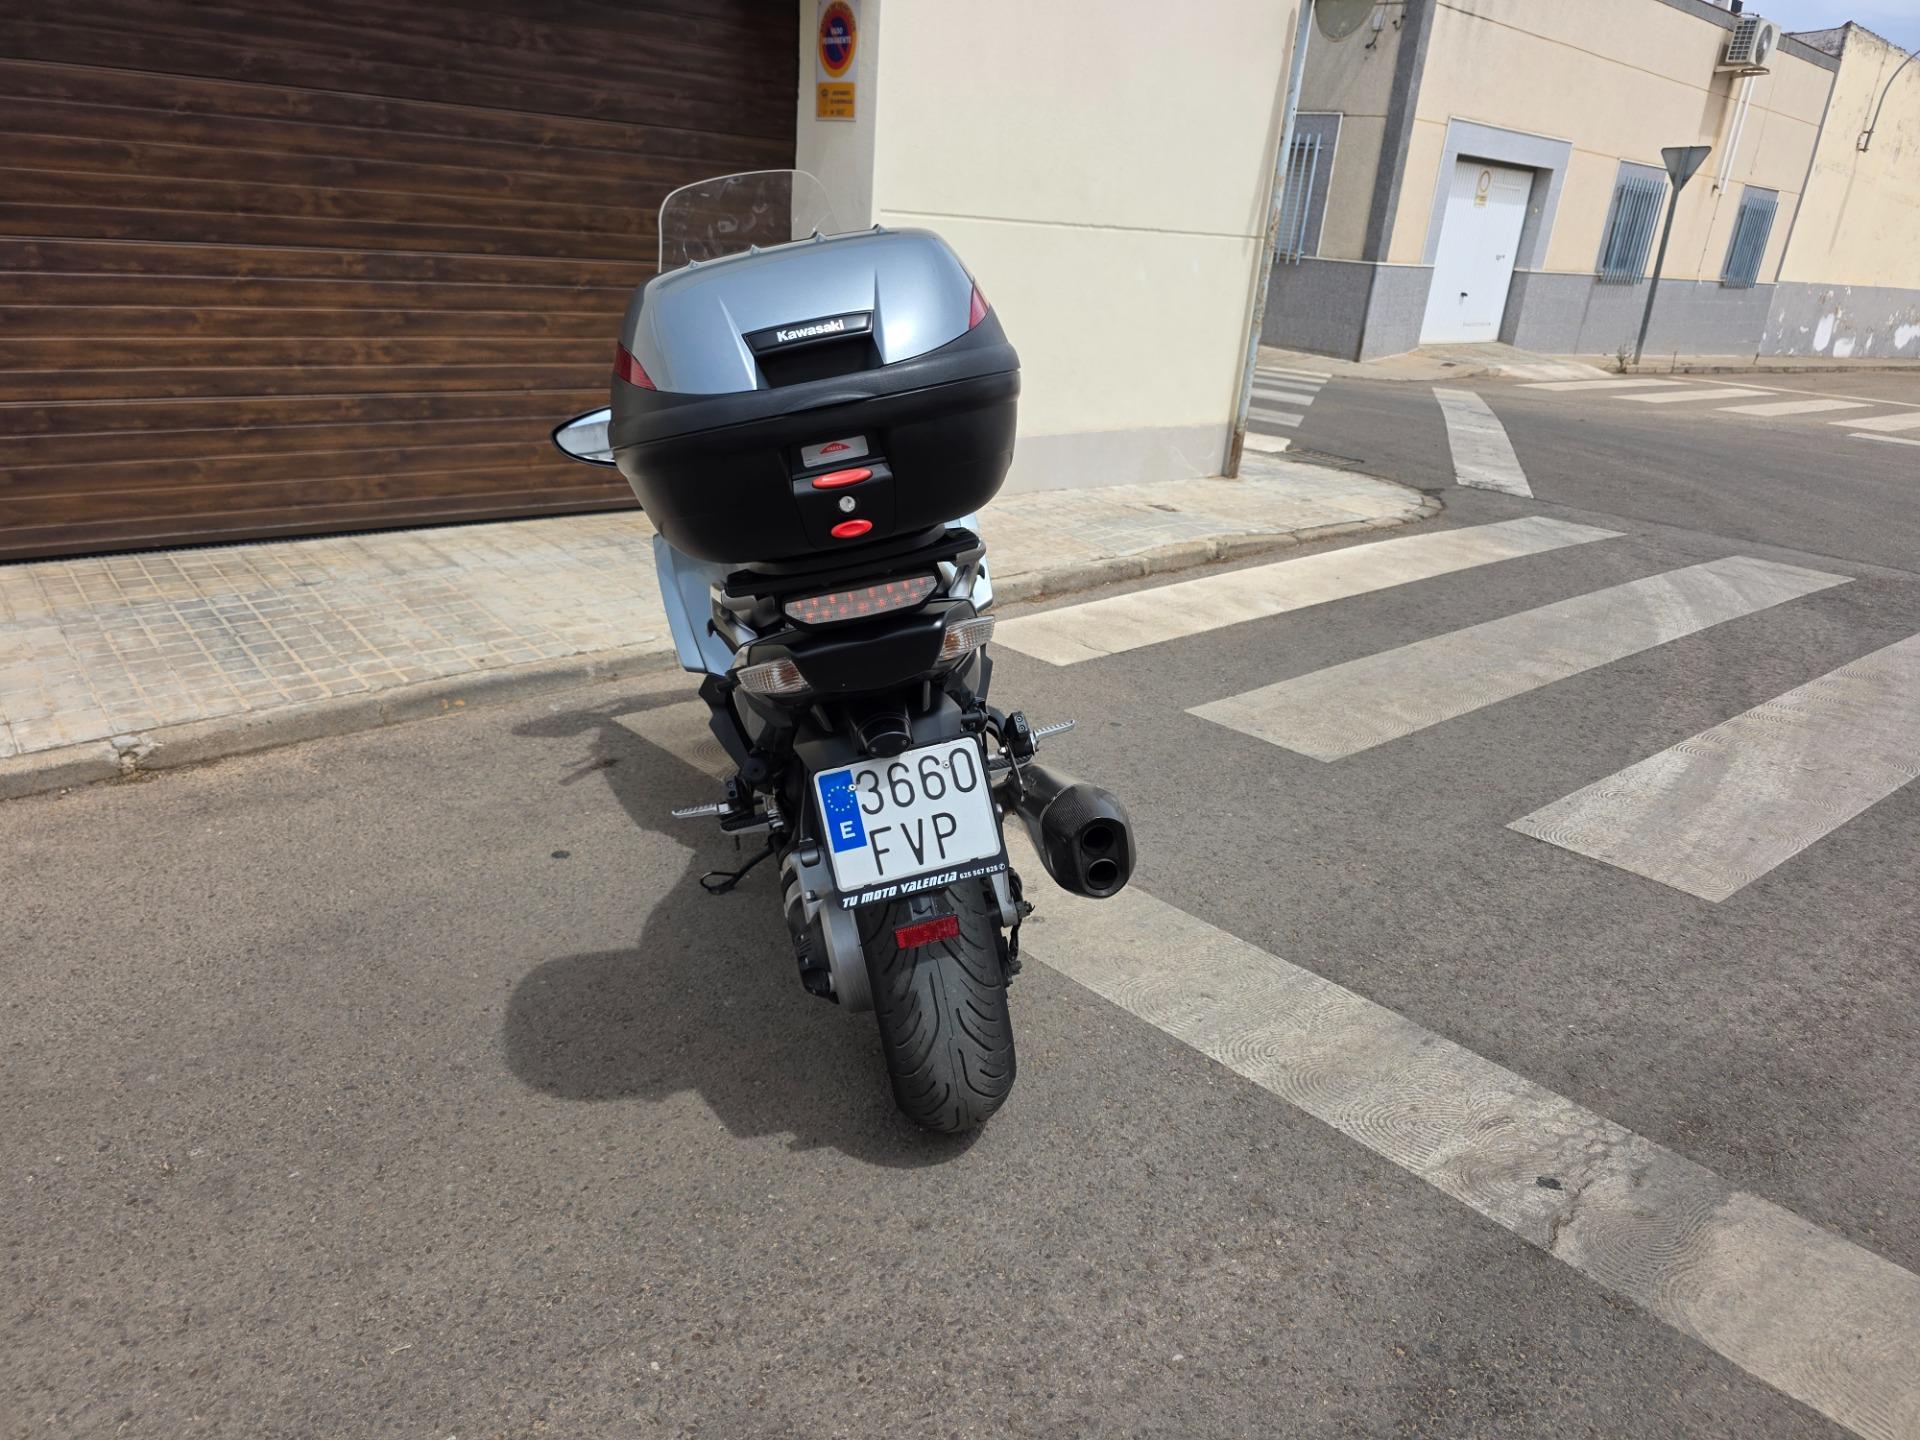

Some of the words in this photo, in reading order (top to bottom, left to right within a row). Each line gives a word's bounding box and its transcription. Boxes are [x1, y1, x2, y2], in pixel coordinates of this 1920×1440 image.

[776, 320, 845, 342] Kawasaki
[856, 748, 977, 815] 3660
[840, 820, 856, 839] E
[869, 812, 957, 876] FVP
[843, 895, 858, 908] TU
